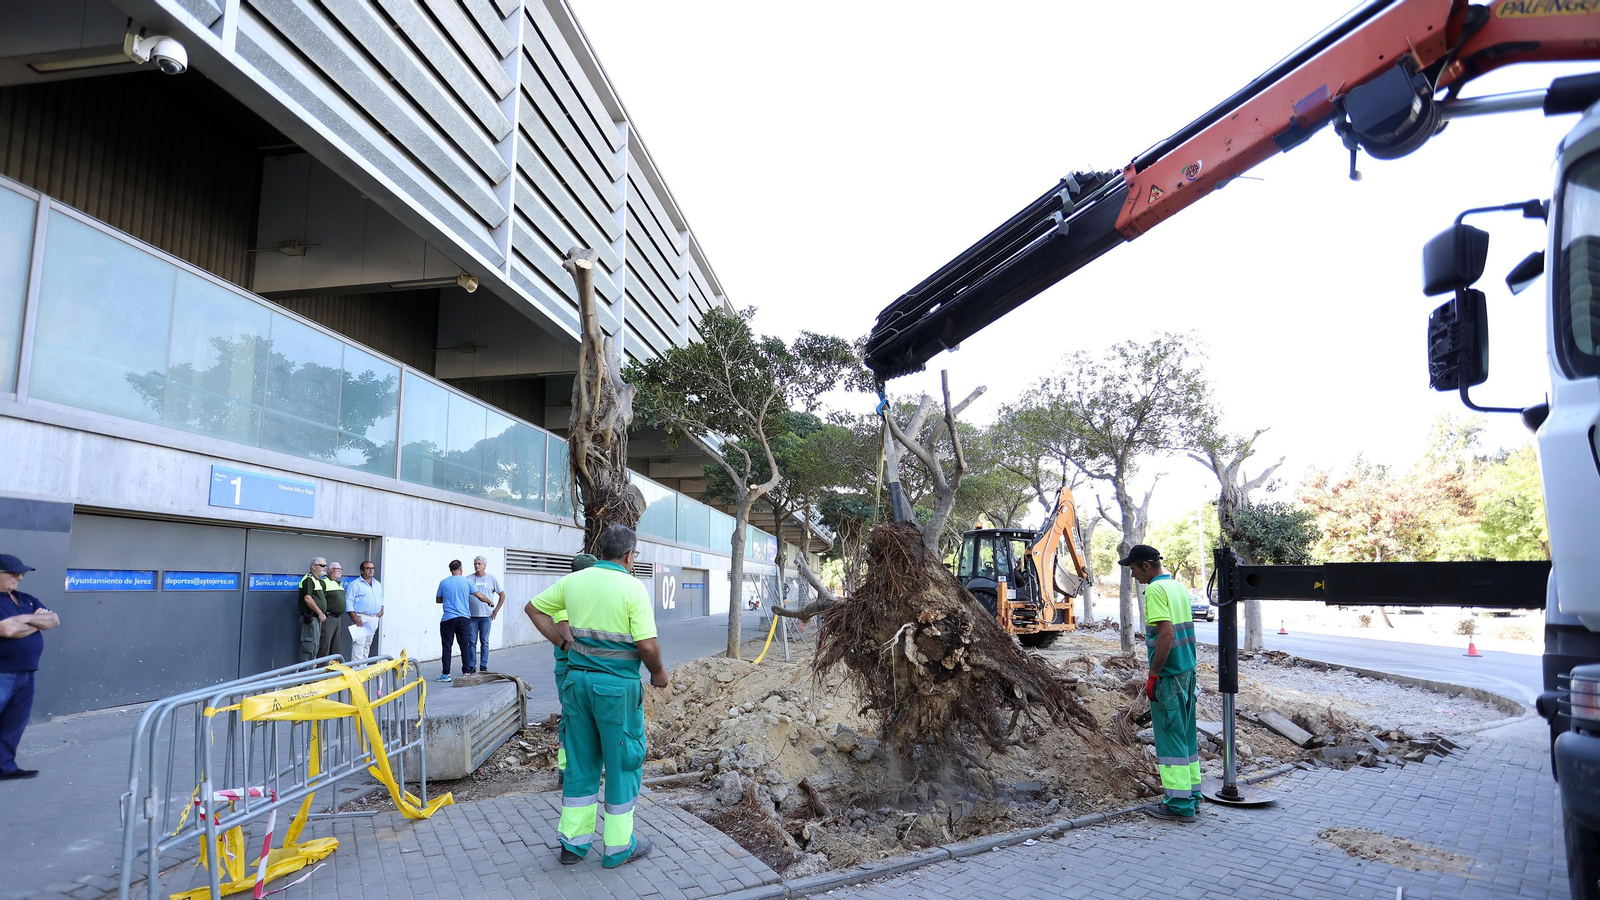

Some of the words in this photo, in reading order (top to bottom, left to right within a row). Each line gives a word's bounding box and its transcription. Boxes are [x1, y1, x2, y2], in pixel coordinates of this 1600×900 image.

[230, 476, 242, 505] 1
[278, 483, 293, 492] Tribuna
[69, 577, 123, 585] Ayuntamiento
[134, 577, 151, 585] Jerez
[165, 577, 234, 586] deportes@aytojerez.es
[662, 575, 676, 610] 02
